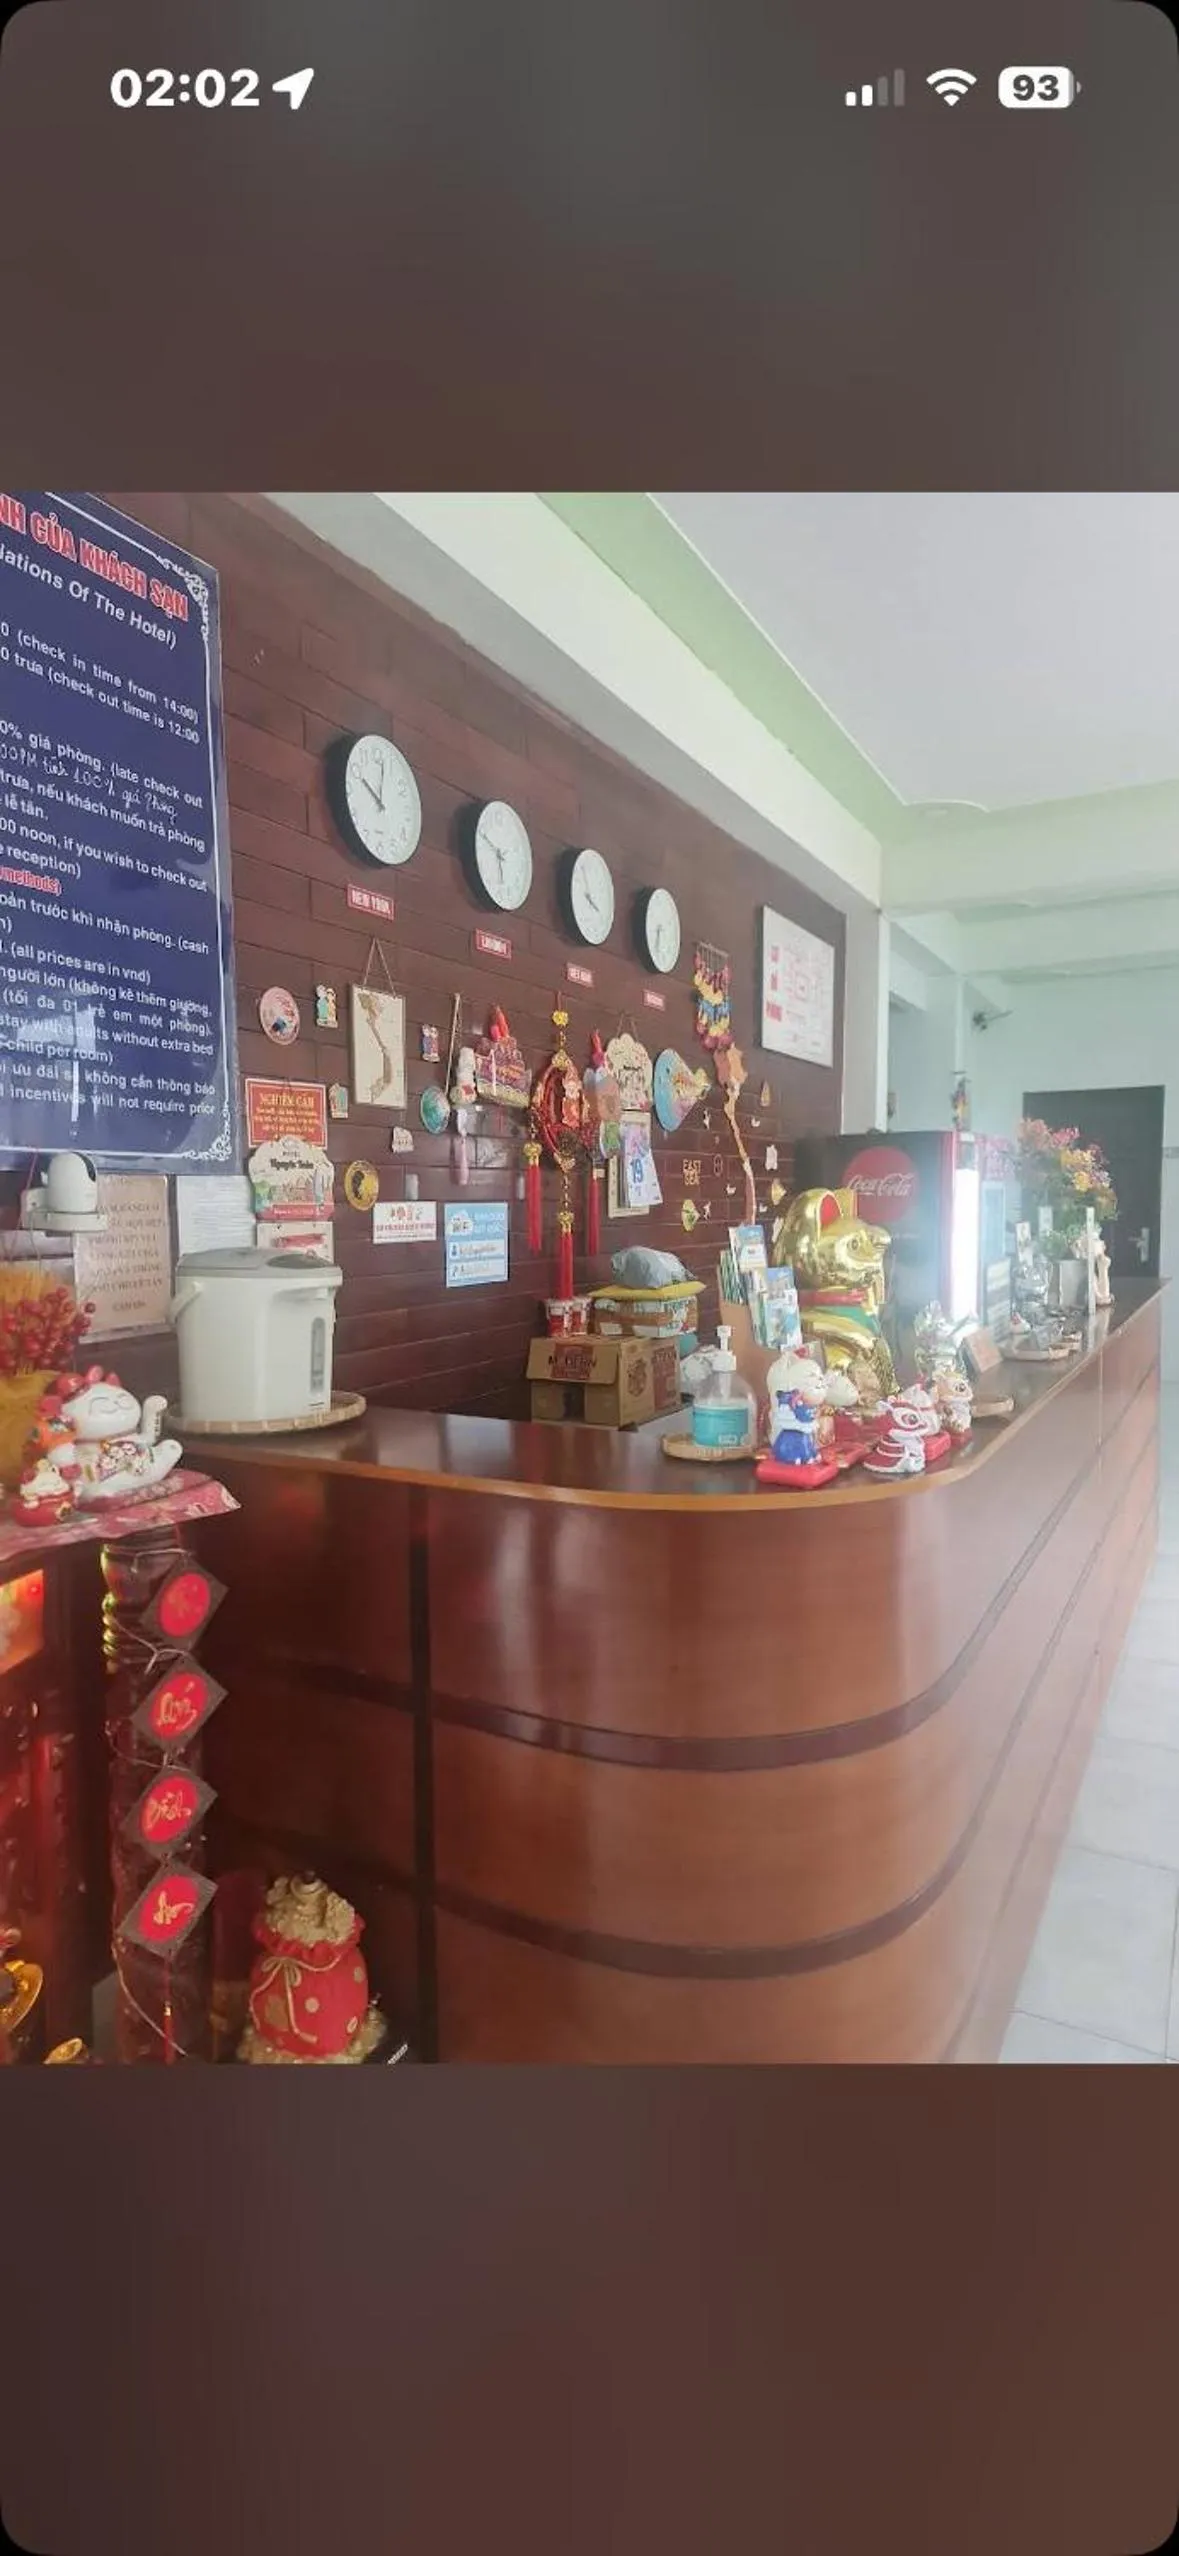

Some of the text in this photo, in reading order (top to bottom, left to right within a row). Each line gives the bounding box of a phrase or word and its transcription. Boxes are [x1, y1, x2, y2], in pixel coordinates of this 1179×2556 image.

[30, 512, 77, 563] CỦA
[80, 538, 147, 599] KHÁCH
[150, 578, 188, 622] SẠN
[69, 581, 89, 602] Of
[93, 592, 125, 622] The
[130, 611, 177, 650] Hotel)
[17, 629, 66, 663] (check
[72, 654, 87, 672] in
[93, 665, 122, 688] time
[127, 679, 157, 705] from
[163, 697, 199, 725] 14:00)
[48, 667, 95, 699] (check
[98, 691, 120, 710] out
[121, 700, 150, 722] time
[153, 714, 164, 729] is
[167, 720, 200, 745] 12:00
[28, 732, 51, 751] giá
[57, 742, 105, 772] phòng.
[110, 762, 139, 784] (late
[143, 777, 180, 800] check
[183, 792, 203, 809] out
[36, 782, 64, 801] nếu
[66, 793, 108, 817] khách
[110, 809, 146, 831] muốn
[149, 819, 166, 837] trả
[167, 827, 206, 853] phòng
[6, 846, 81, 879] reception)
[19, 826, 61, 849] noon,
[63, 836, 73, 850] if
[76, 841, 102, 860] you
[103, 848, 134, 869] wish
[136, 860, 149, 874] to
[151, 865, 187, 885] check
[188, 876, 208, 893] out
[30, 899, 69, 920] trước
[72, 909, 94, 926] khi
[96, 917, 130, 937] nhận
[132, 927, 176, 948] phòng.
[178, 936, 209, 955] (cash
[11, 941, 151, 984] (all prices are in vnd)
[3, 989, 29, 1006] (tối
[37, 994, 56, 1010] đa
[113, 1009, 133, 1022] em
[139, 1012, 163, 1028] một
[43, 971, 66, 989] lớn
[69, 977, 117, 1001] (không
[136, 992, 167, 1008] thêm
[32, 1020, 67, 1035] with
[112, 1029, 159, 1048] without
[161, 1036, 190, 1053] extra
[192, 1041, 214, 1056] bed
[47, 1045, 70, 1059] per
[73, 1047, 114, 1066] room)
[84, 1069, 127, 1090] không
[157, 1078, 191, 1096] thông
[90, 1092, 114, 1107] will
[118, 1097, 140, 1109] not
[143, 1099, 186, 1114] require
